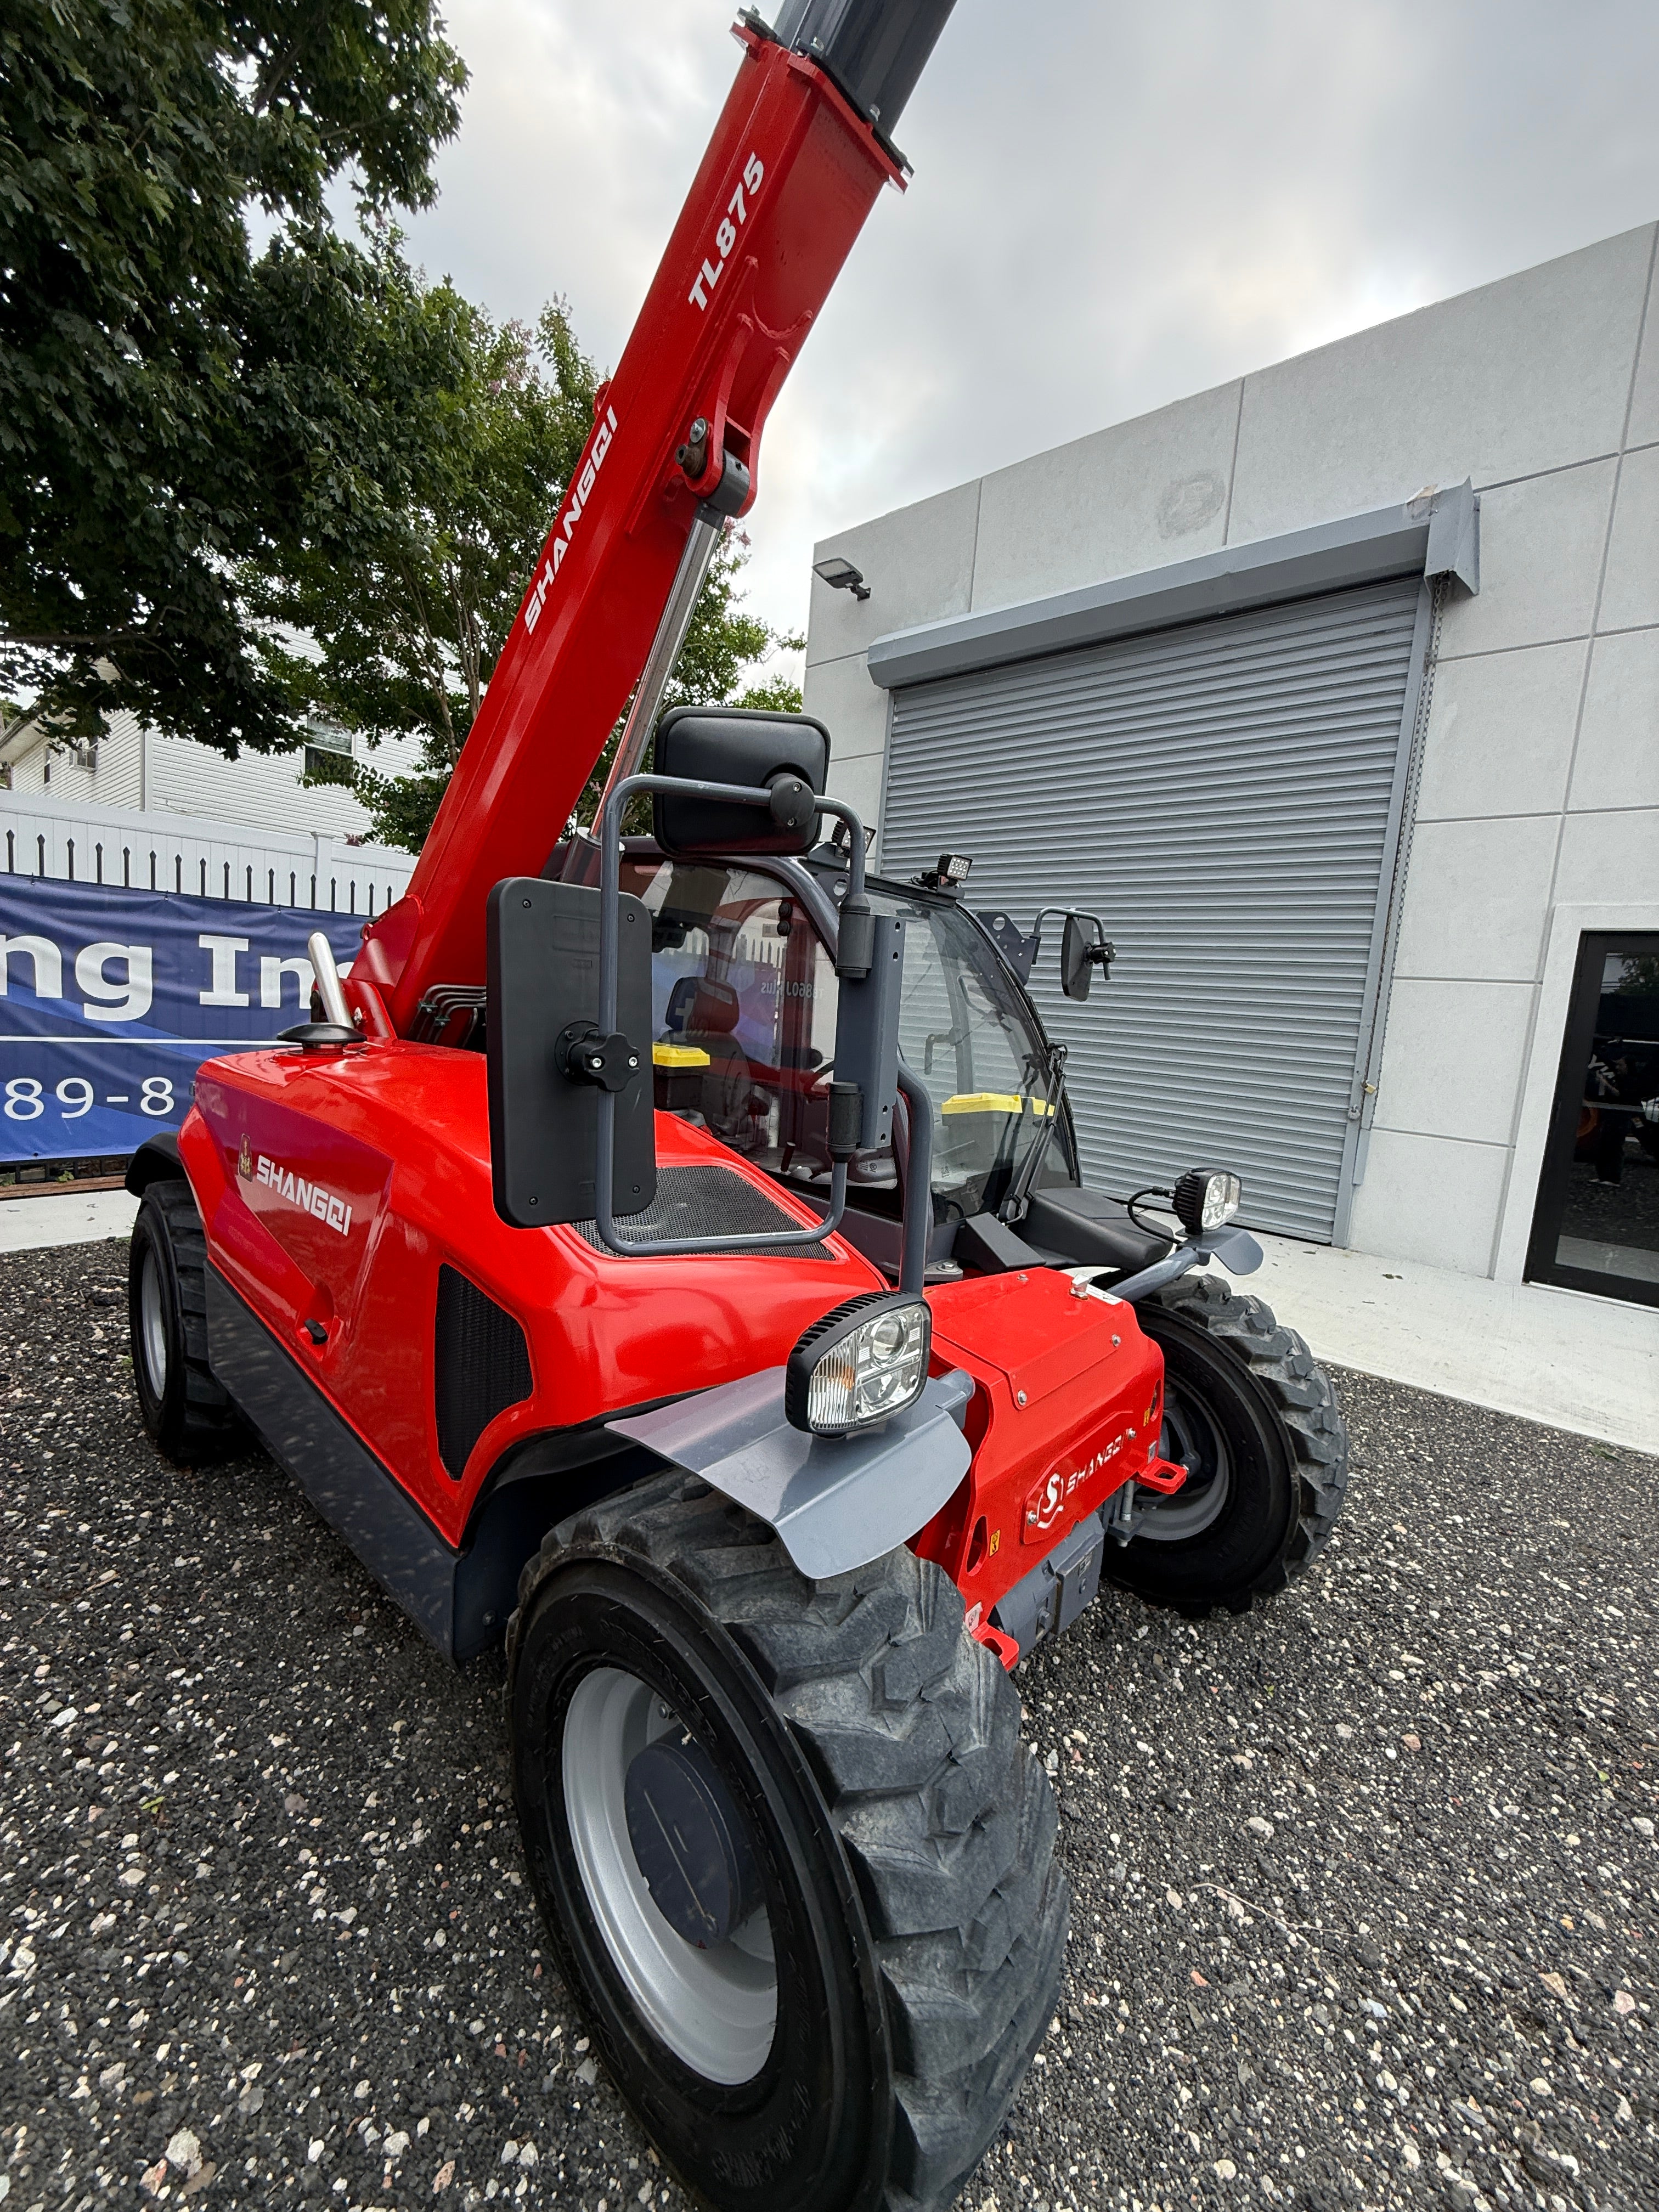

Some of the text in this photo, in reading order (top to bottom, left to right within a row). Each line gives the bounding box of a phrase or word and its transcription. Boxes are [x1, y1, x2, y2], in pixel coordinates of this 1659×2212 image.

[688, 151, 764, 312] TL875
[524, 404, 618, 636] SHANGQI
[0, 934, 354, 1022] ng In
[4, 1077, 174, 1120] 89-8
[256, 1154, 352, 1237] SHANGQI
